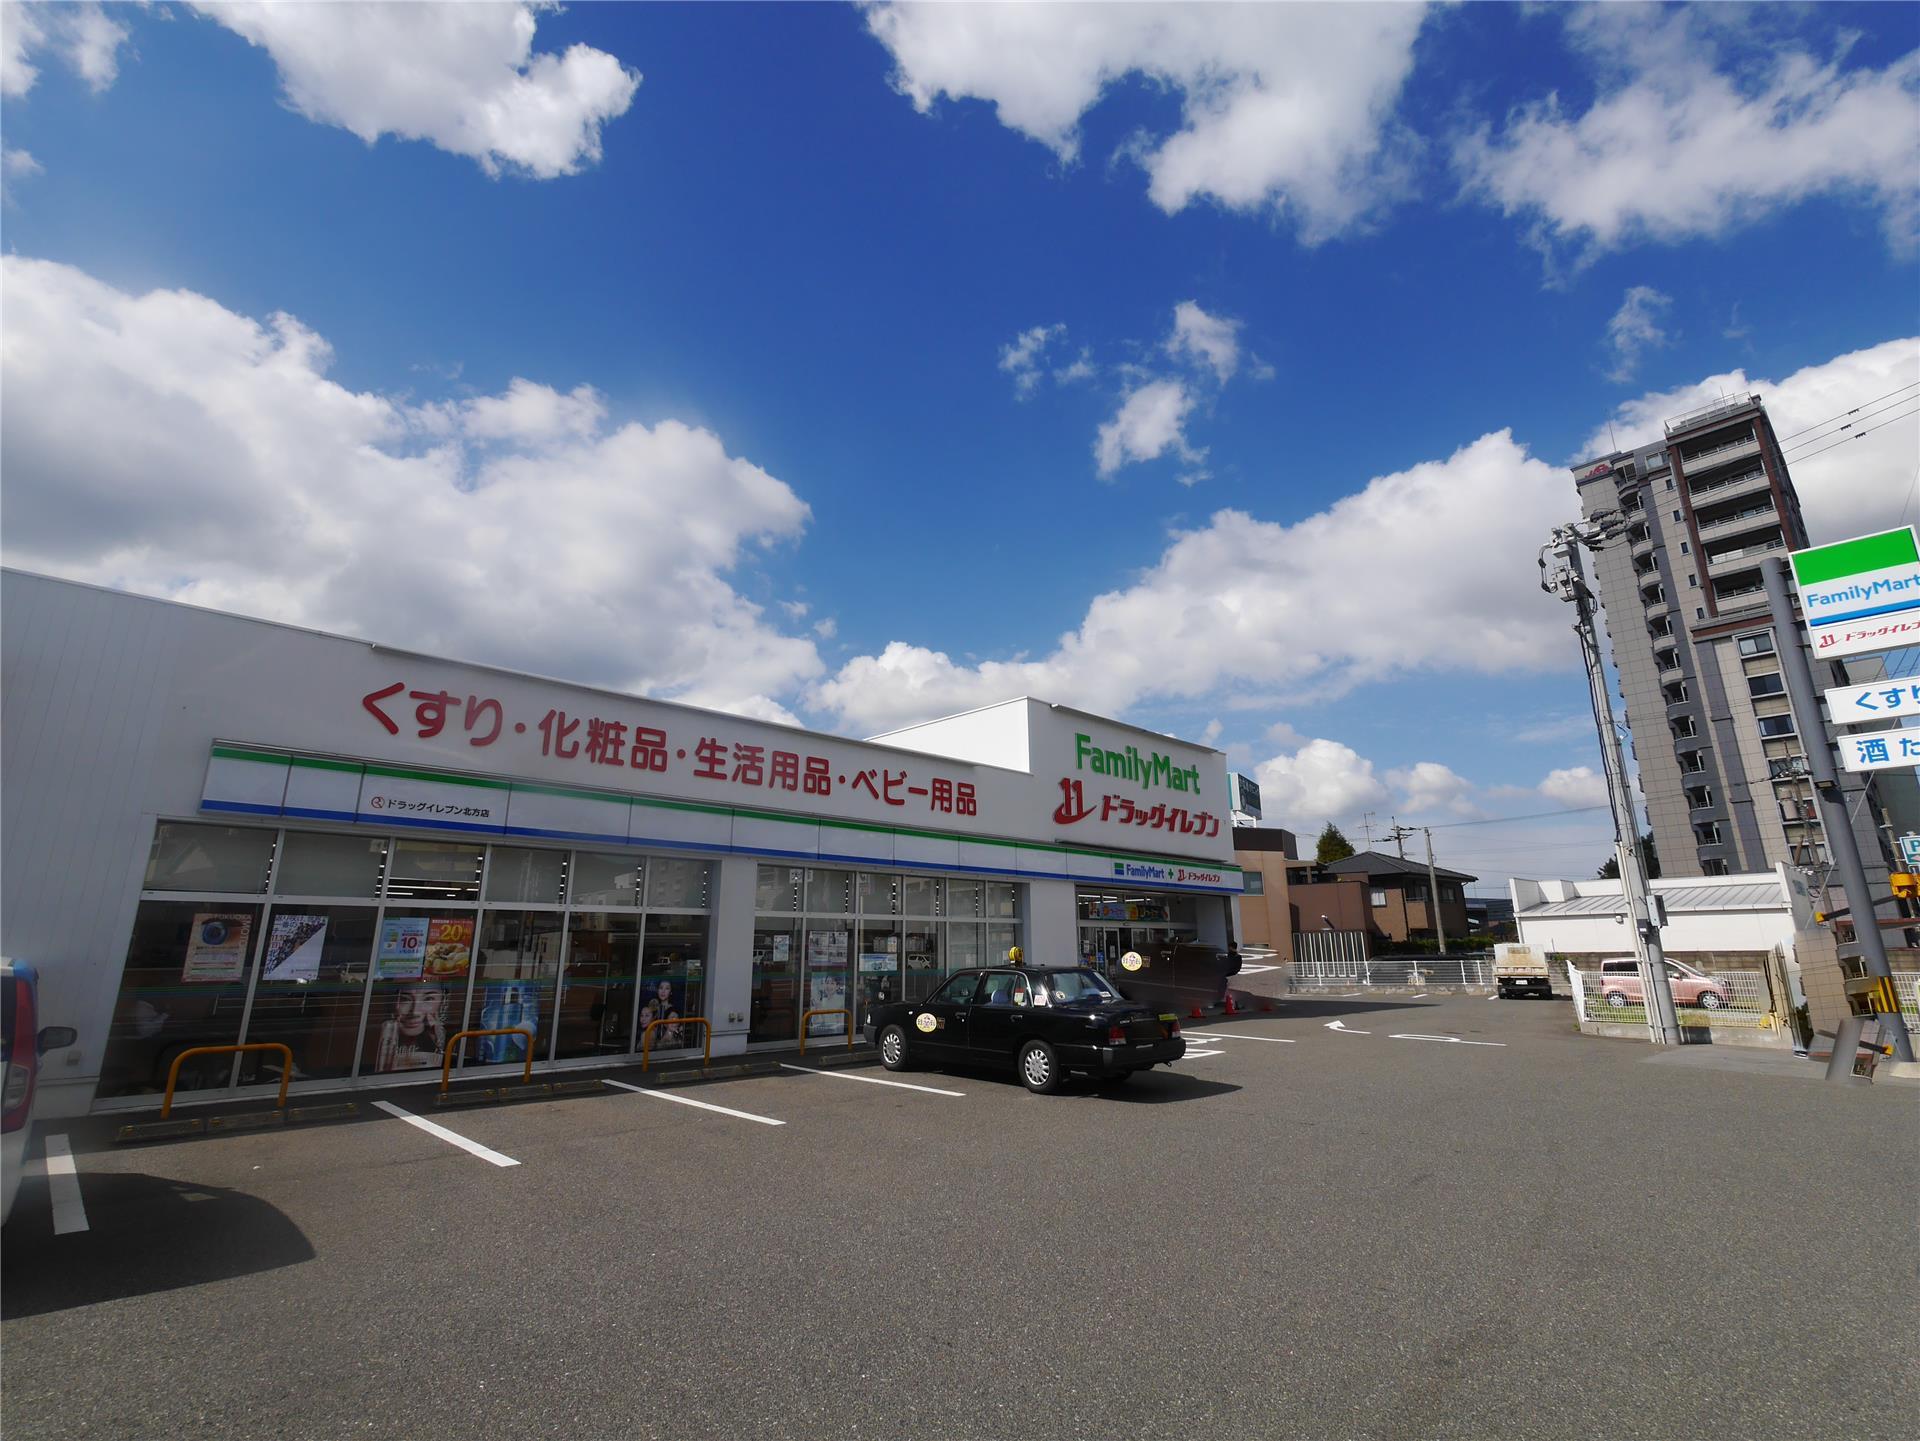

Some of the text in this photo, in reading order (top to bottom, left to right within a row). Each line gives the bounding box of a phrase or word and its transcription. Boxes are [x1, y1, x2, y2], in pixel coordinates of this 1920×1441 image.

[1807, 574, 1920, 608] FamilyMart
[1075, 732, 1201, 795] FamilyMart
[387, 799, 490, 818] ドラッグイレブン北方店
[1101, 794, 1220, 838] ドラッグイレブン
[1126, 864, 1164, 880] FamilyMart
